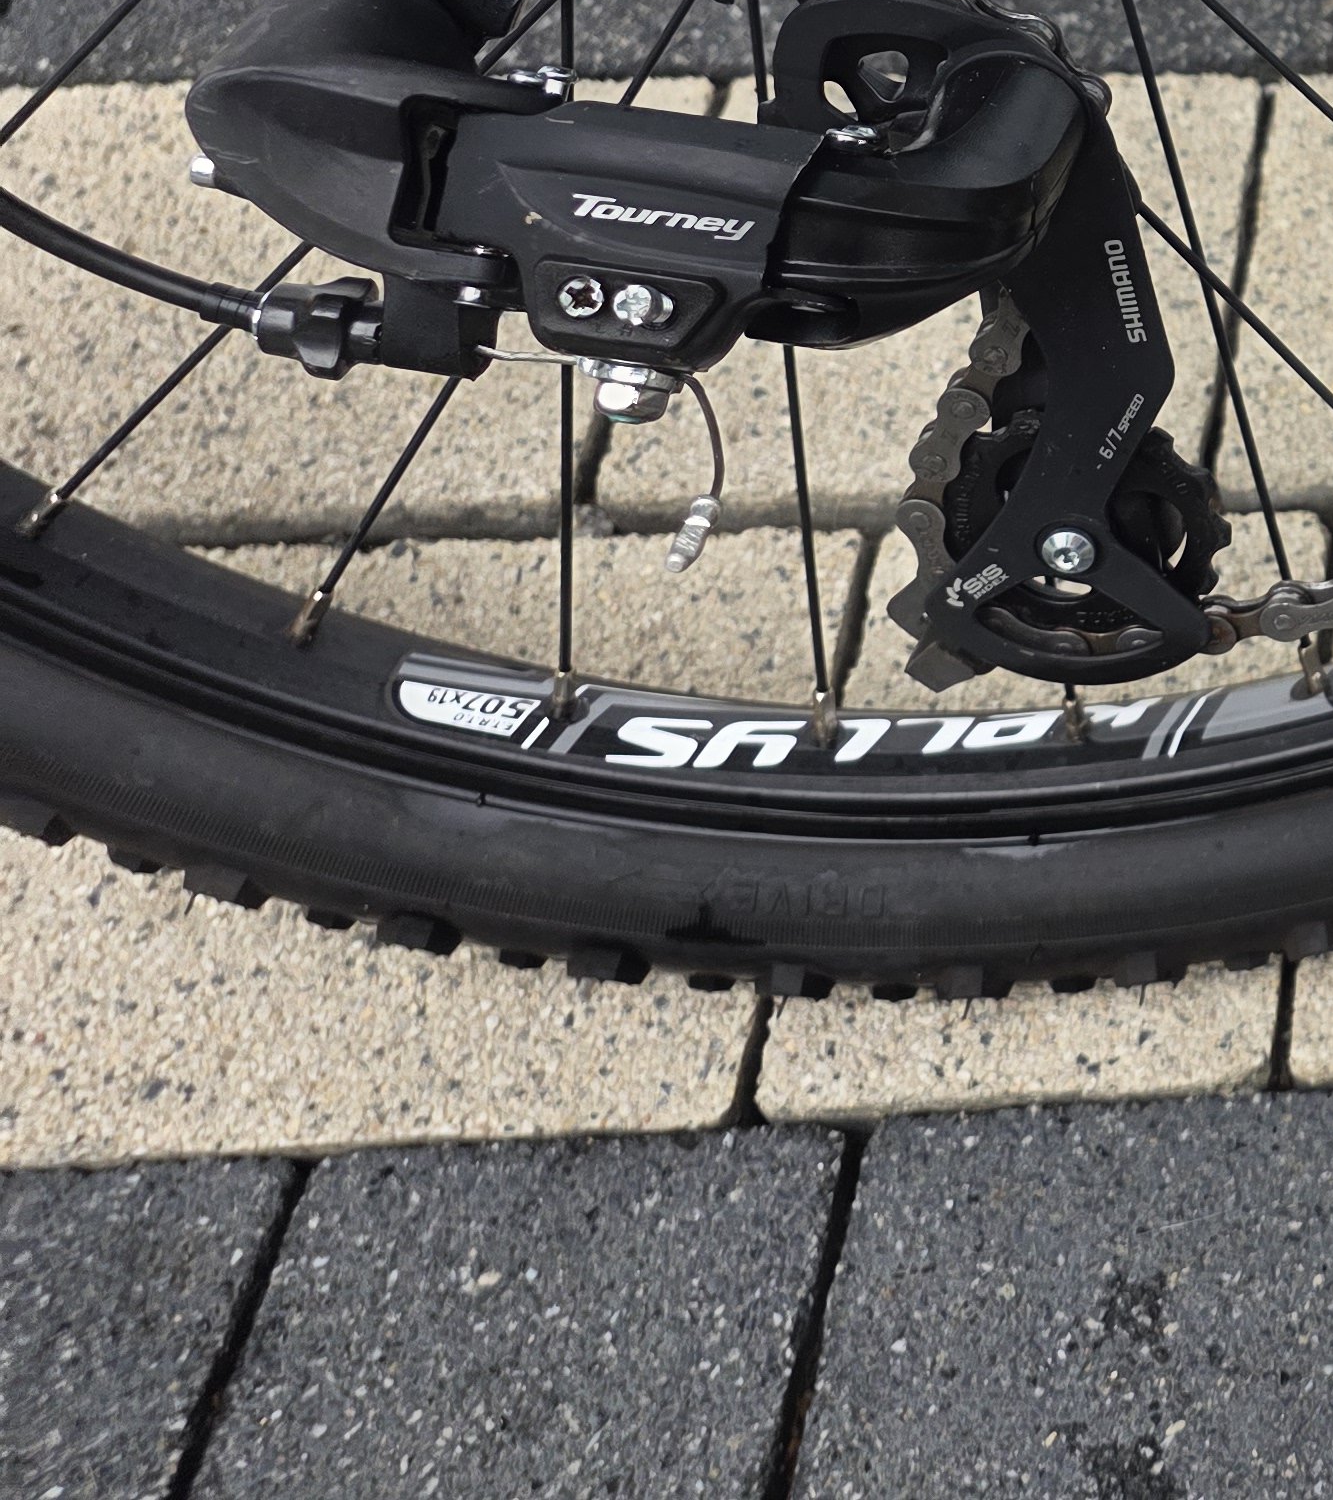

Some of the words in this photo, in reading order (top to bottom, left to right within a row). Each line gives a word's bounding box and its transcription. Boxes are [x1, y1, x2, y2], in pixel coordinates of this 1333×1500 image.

[572, 193, 756, 241] Tourney
[1104, 239, 1148, 343] SHIMANO
[973, 572, 1011, 601] INDEX
